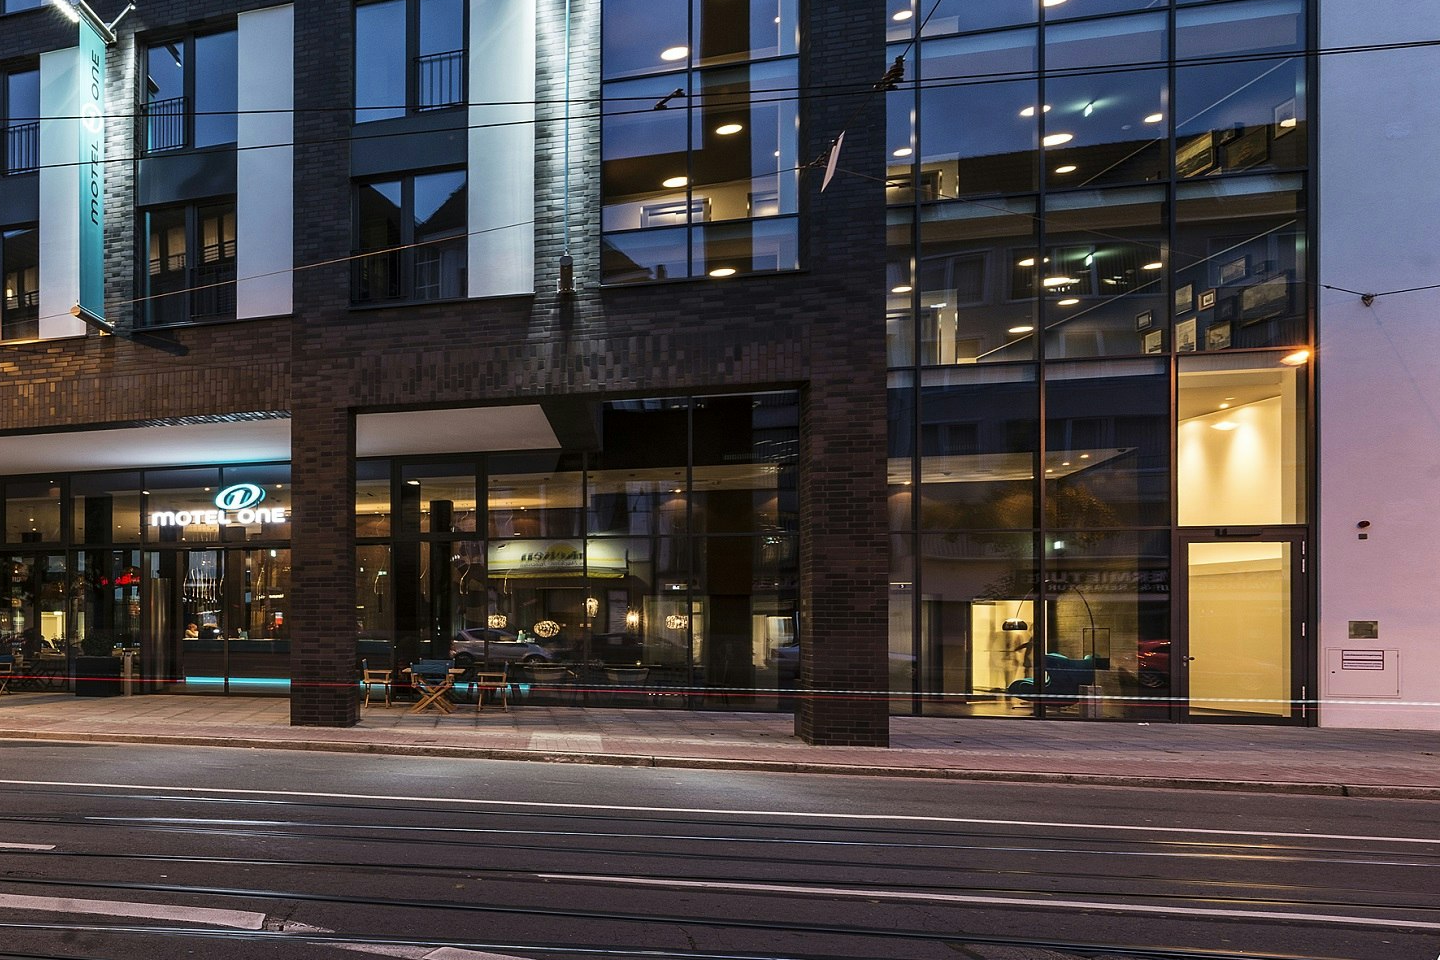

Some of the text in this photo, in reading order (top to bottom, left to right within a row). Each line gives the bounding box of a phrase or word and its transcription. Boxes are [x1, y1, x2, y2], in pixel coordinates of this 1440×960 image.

[91, 49, 101, 101] ONE
[153, 508, 286, 526] MOTEL ONE
